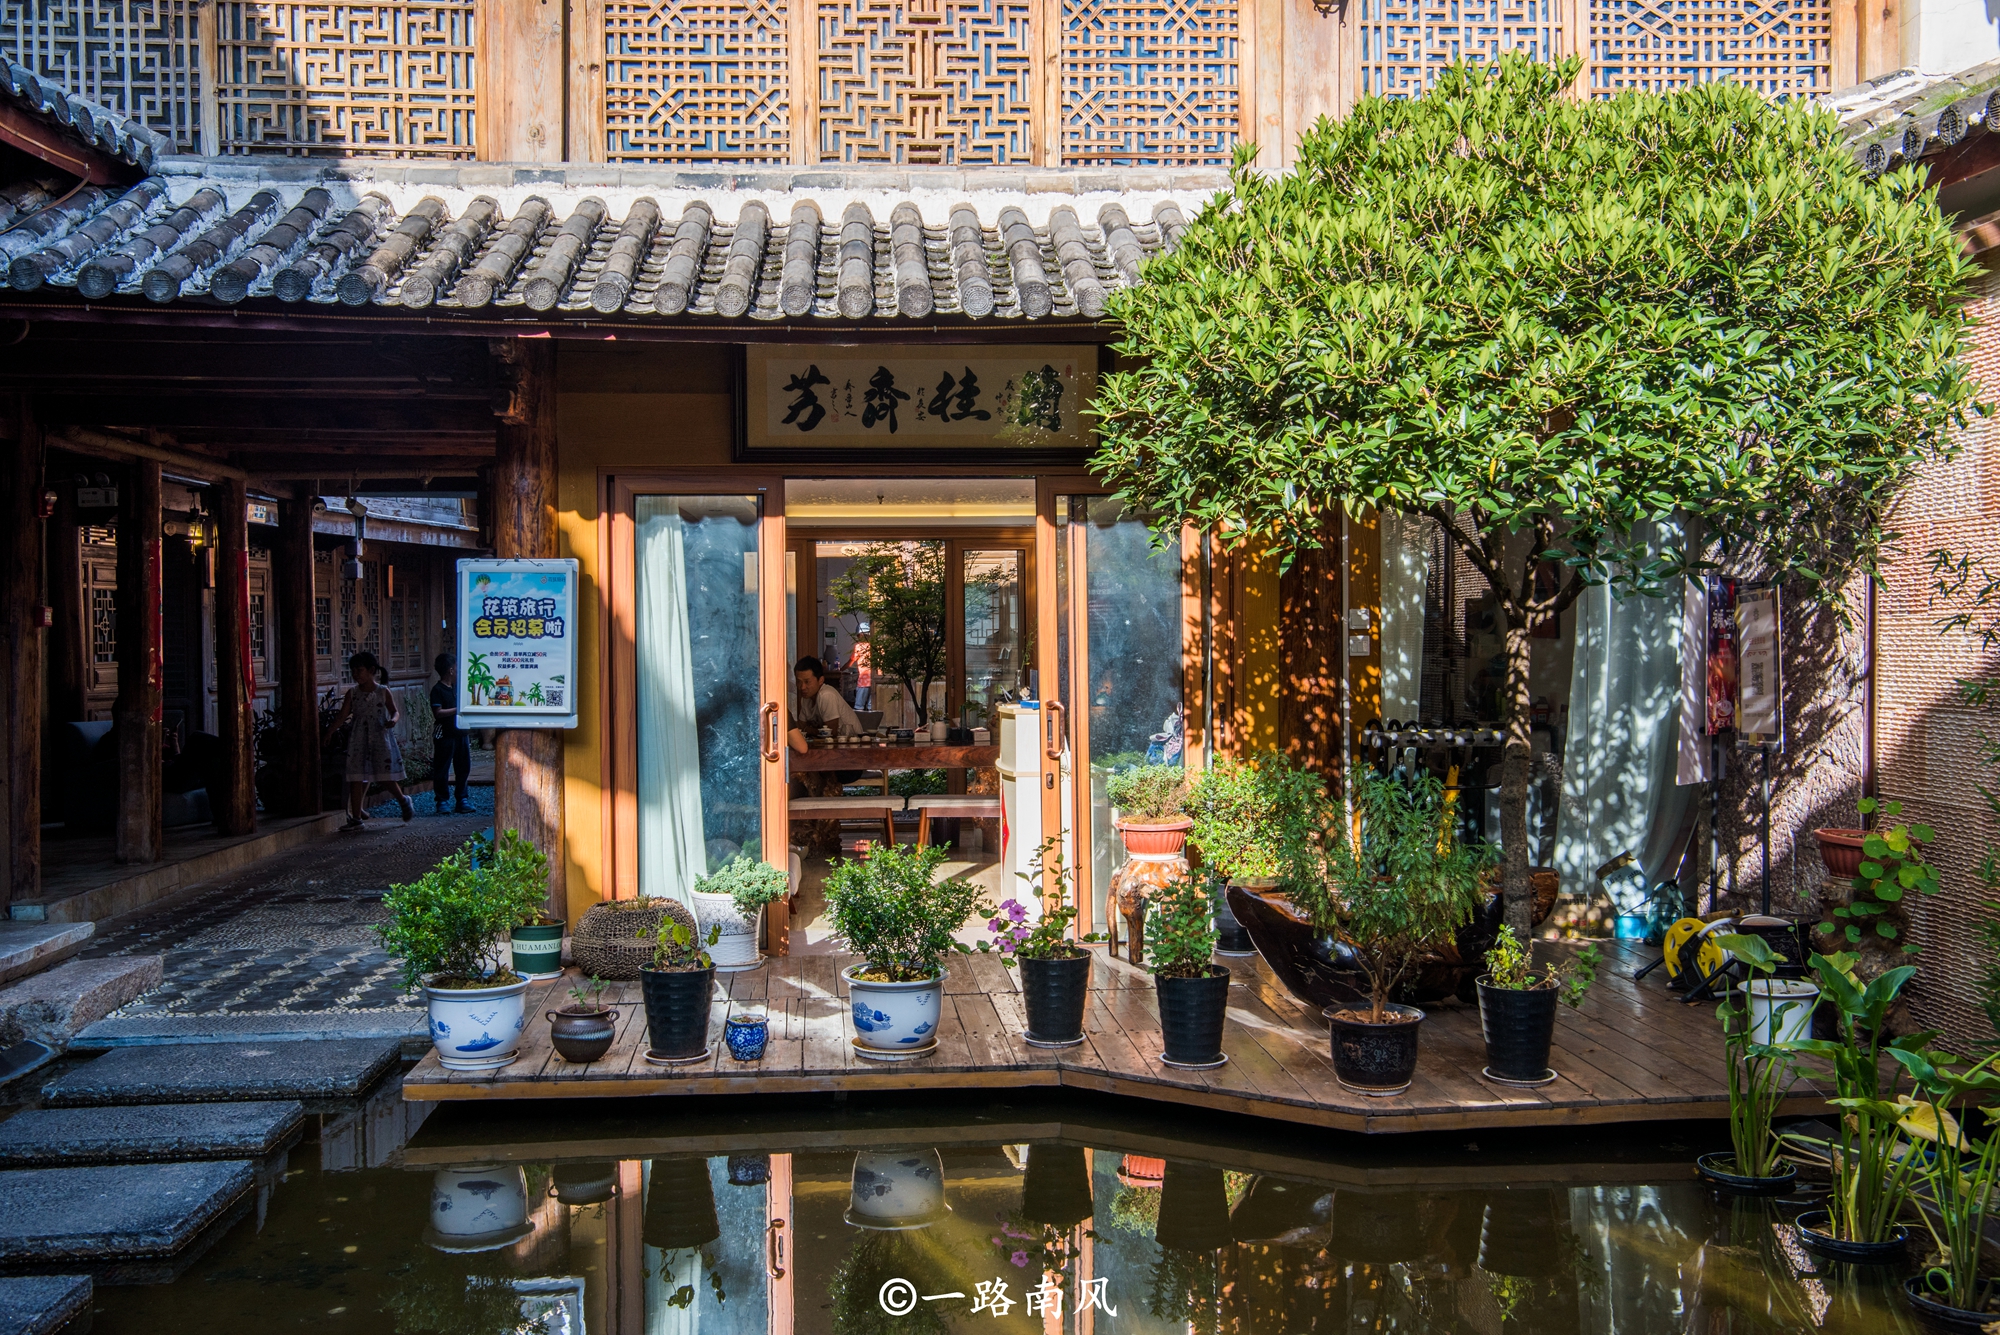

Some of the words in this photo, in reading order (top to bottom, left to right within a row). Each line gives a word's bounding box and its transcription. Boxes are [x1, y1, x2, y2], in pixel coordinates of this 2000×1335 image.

[484, 598, 555, 616] 花筑旅行
[475, 619, 562, 636] 会员招募啦
